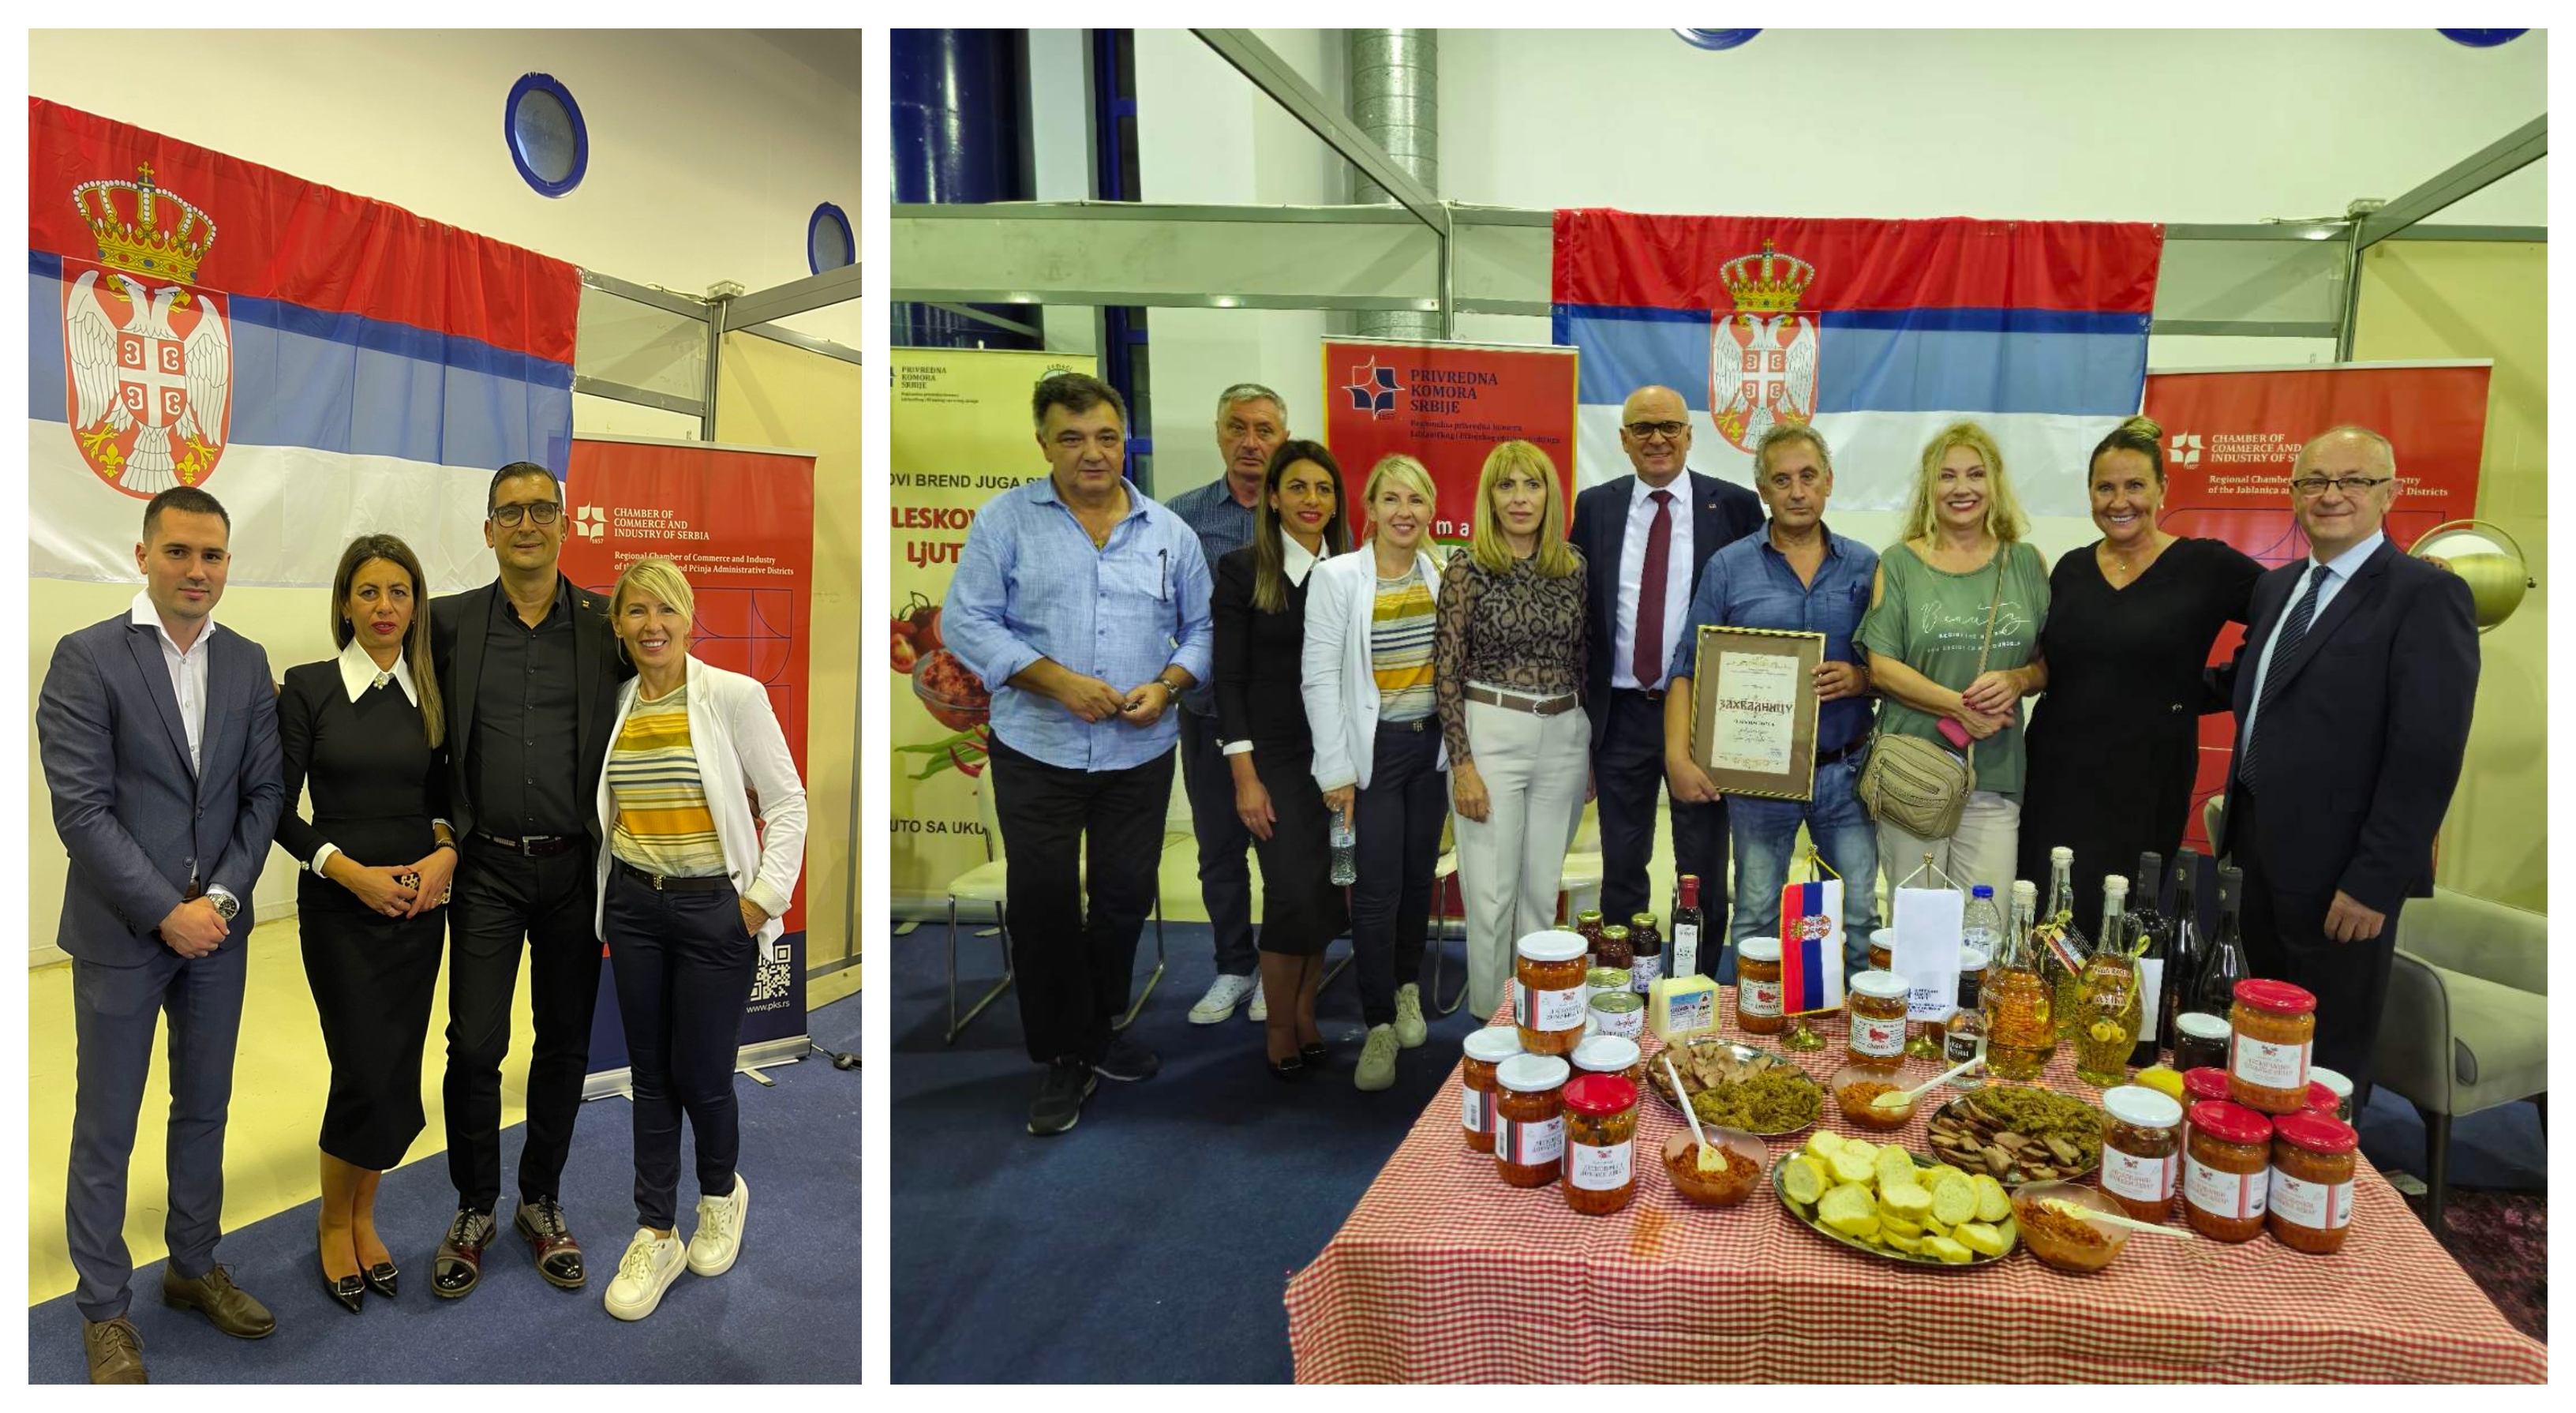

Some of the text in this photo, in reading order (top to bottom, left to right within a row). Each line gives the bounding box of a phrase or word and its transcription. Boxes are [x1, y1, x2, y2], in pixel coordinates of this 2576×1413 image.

[1410, 369, 1498, 385] PRIVREDNA
[1410, 384, 1477, 399] KOMORA
[1410, 400, 1460, 414] SRBIJE
[2212, 433, 2286, 443] CHAMBER OF
[2211, 444, 2302, 453] COMMERCE AND
[2211, 453, 2268, 463] INDUSTRY
[2271, 454, 2286, 463] OF
[915, 474, 971, 488] BREND
[975, 475, 1020, 489] JUGA
[2210, 475, 2249, 485] Regional
[2220, 485, 2234, 494] the
[2407, 487, 2448, 496] Districts
[614, 508, 674, 519] CHAMBER OF
[614, 518, 688, 530] COMMERCE AND
[614, 528, 710, 541] INDUSTRY OF SERBIA
[615, 551, 648, 561] Regional
[692, 553, 729, 563] Commerce
[732, 554, 744, 563] and
[746, 555, 776, 565] Industry
[689, 564, 712, 573] Pčinja
[713, 565, 766, 575] Administrative
[767, 567, 794, 575] Districts
[1718, 698, 1793, 715] ЗАХВАЛНИЦУ
[926, 820, 948, 834] SA
[746, 1000, 791, 1014] www.pks.rs
